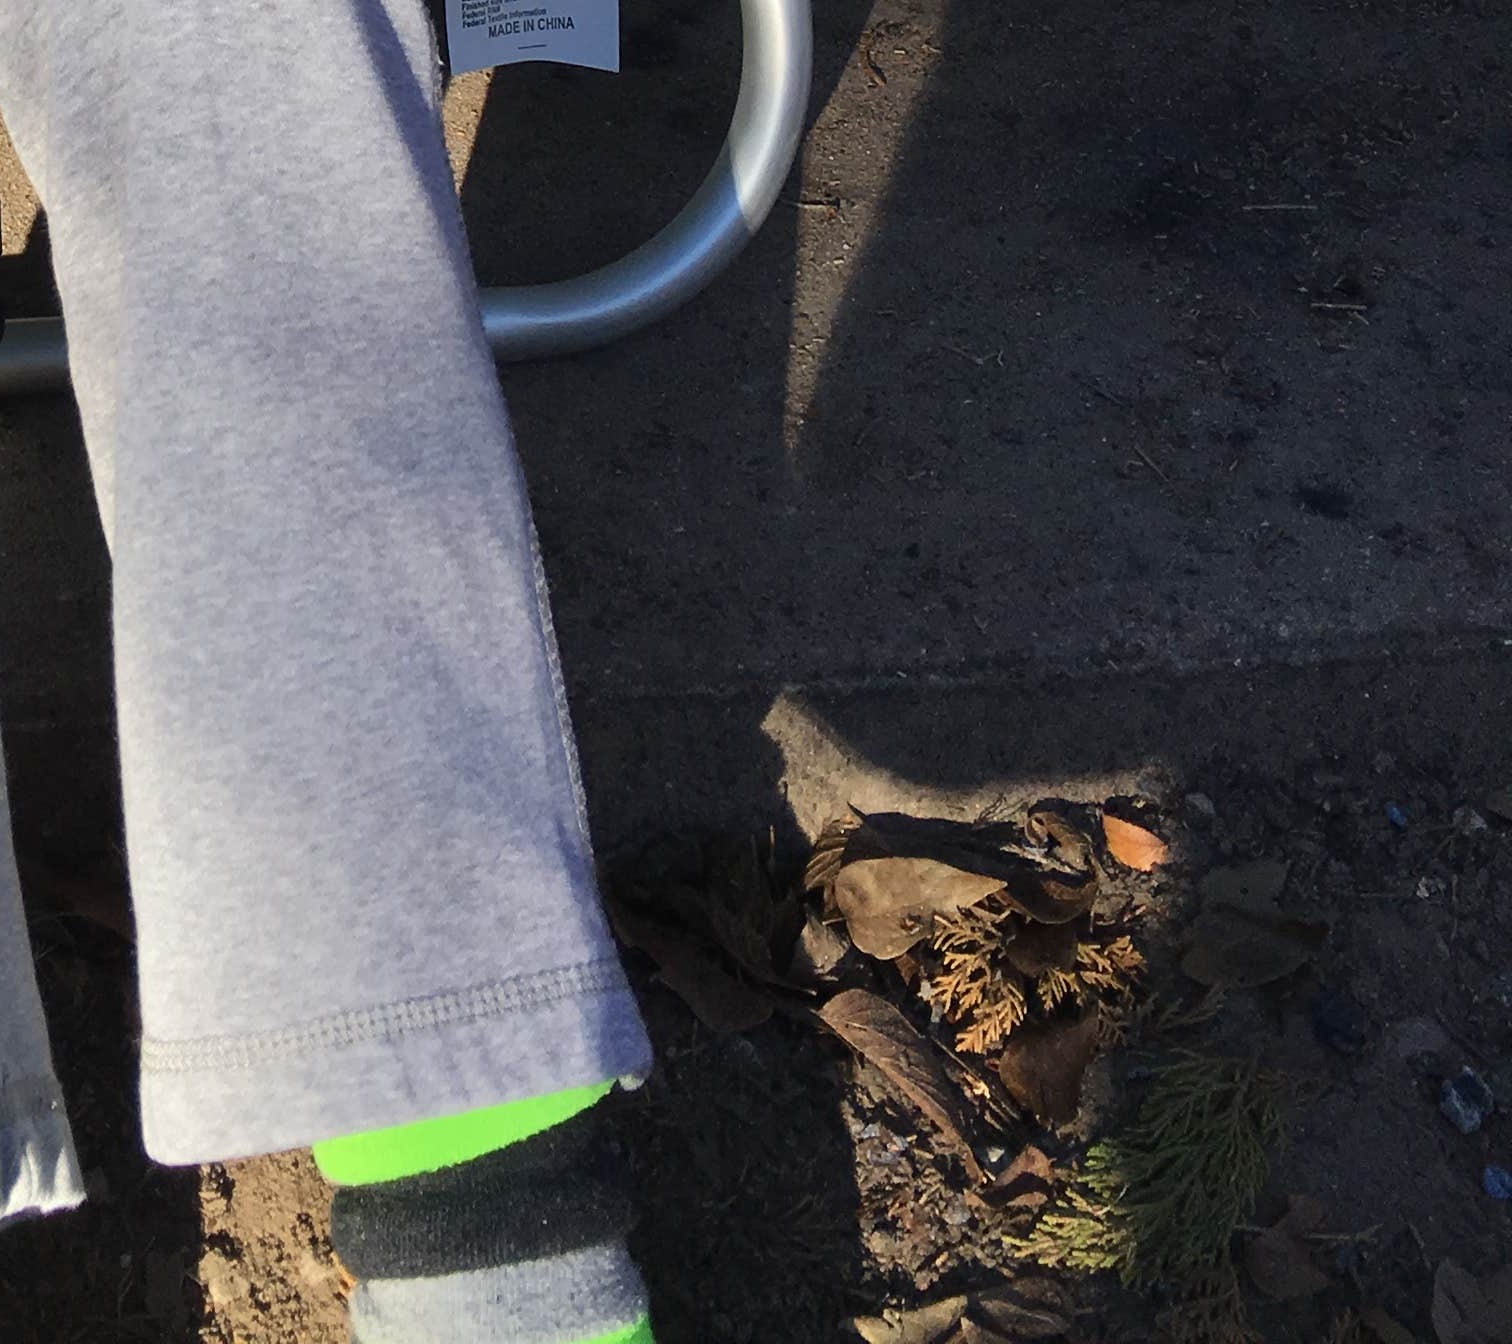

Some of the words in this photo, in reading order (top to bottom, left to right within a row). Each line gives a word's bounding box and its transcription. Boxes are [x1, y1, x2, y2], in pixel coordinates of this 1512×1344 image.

[462, 17, 487, 28] Federal
[488, 21, 521, 39] MADE
[523, 18, 534, 33] IN
[537, 16, 576, 31] CHINA
